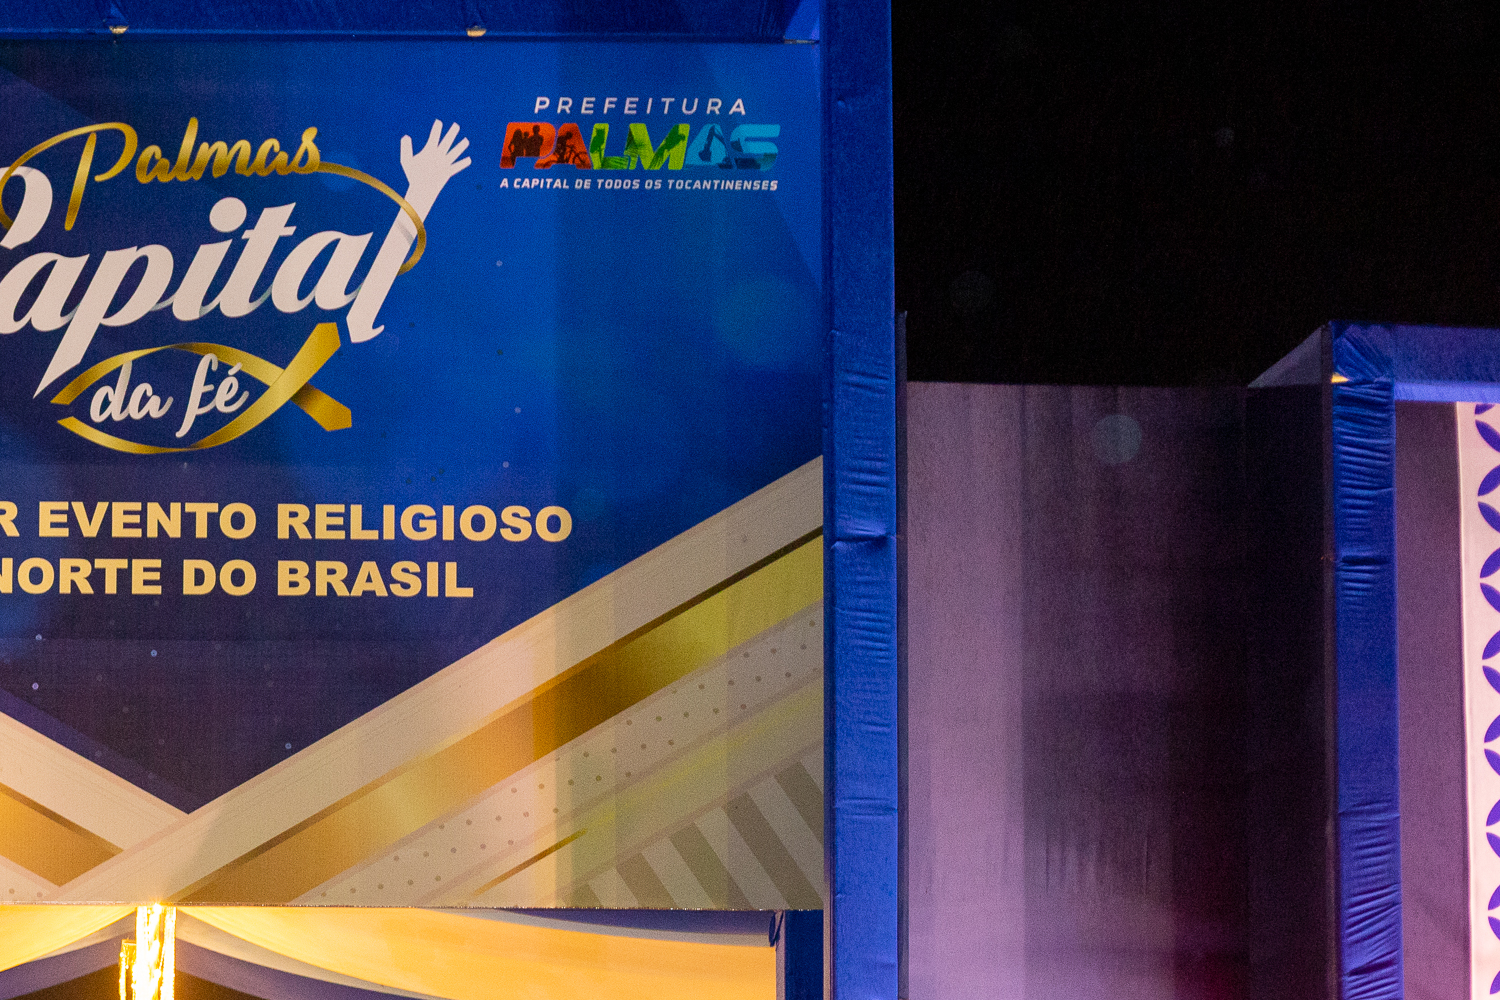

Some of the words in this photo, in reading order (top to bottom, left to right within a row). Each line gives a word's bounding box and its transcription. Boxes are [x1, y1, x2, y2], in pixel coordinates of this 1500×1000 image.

[534, 96, 746, 115] PREFEITURA
[499, 121, 781, 172] PALMAS
[500, 177, 509, 188] A
[513, 177, 570, 189] CAPITAL
[575, 178, 591, 189] DE
[597, 178, 640, 189] TODOS
[644, 179, 662, 190] OS
[668, 179, 778, 191] TOCANTINENSES
[90, 358, 174, 424] da
[175, 352, 249, 438] fé
[38, 501, 257, 540] EVENTO
[277, 503, 573, 543] RELIGIOSO
[182, 559, 257, 597] DO
[277, 560, 474, 598] BRASIL
